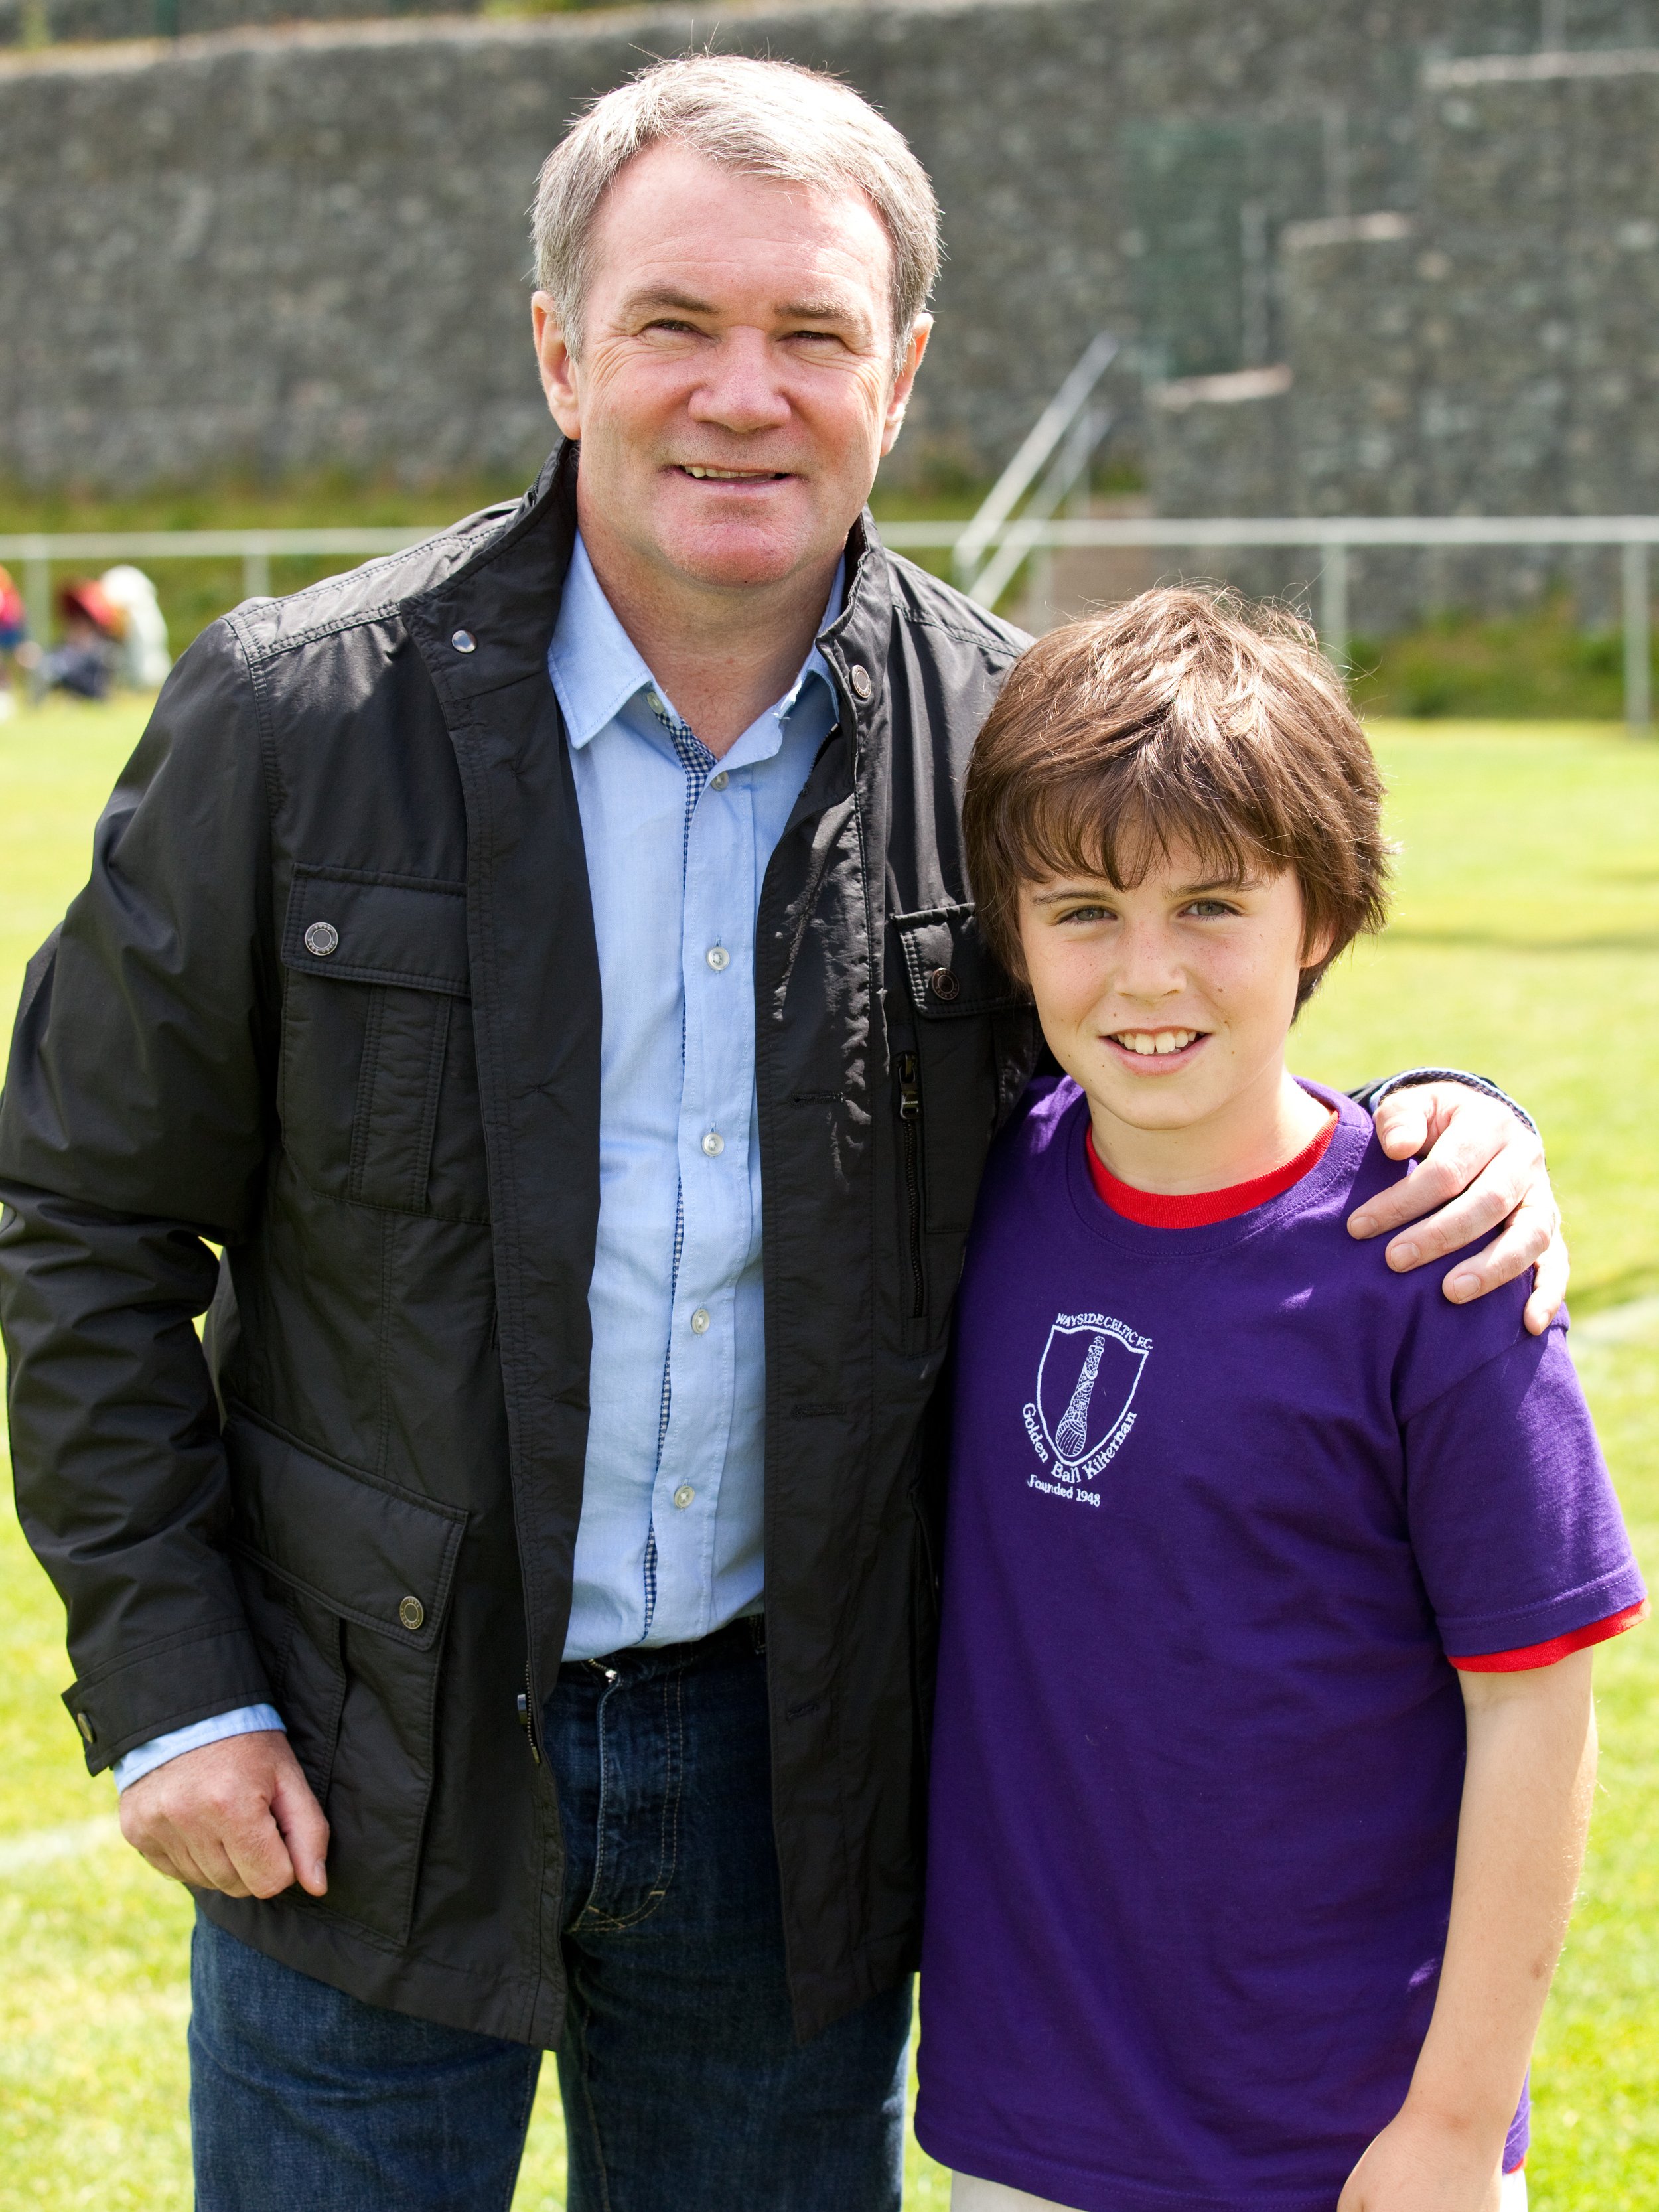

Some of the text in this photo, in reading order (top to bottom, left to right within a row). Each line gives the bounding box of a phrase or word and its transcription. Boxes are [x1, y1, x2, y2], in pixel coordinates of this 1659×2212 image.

[1056, 1313, 1104, 1327] WAYSIDE
[1104, 1317, 1138, 1343] CELTIC
[1023, 1403, 1137, 1483] Golden Ball Kilternan
[1027, 1474, 1101, 1507] Founded 1948
